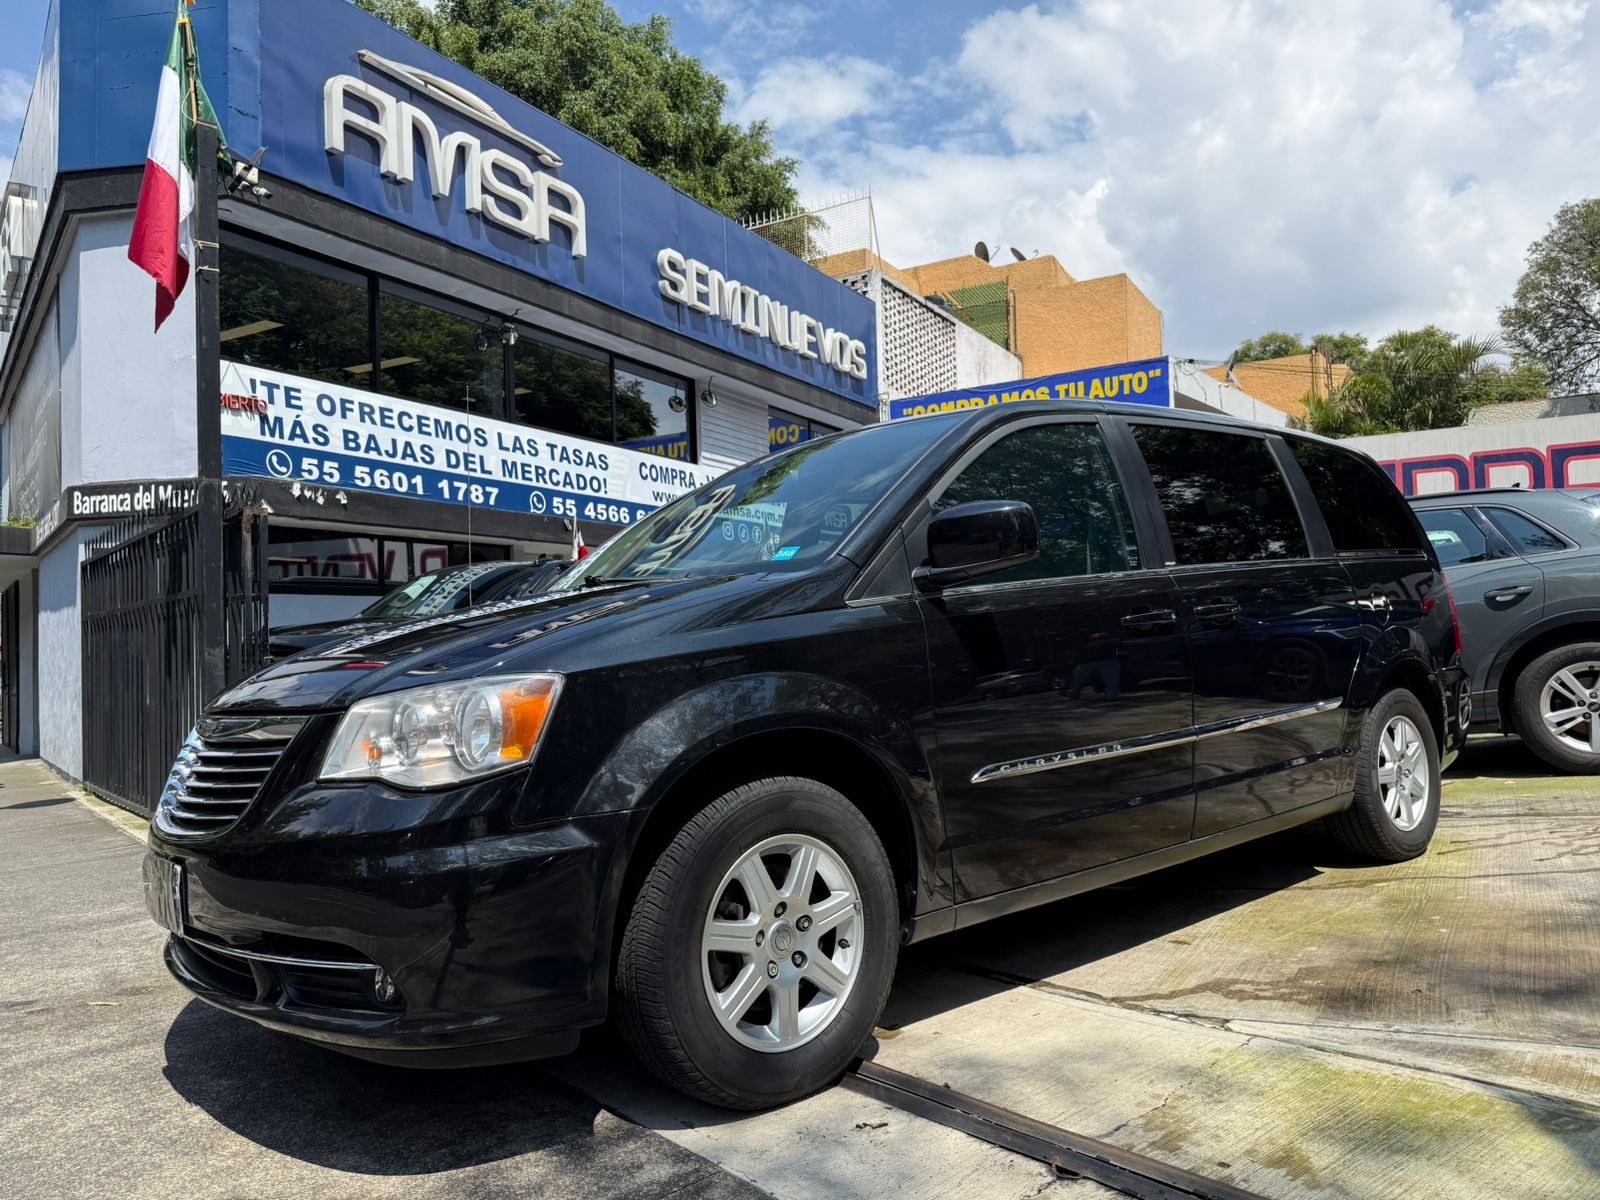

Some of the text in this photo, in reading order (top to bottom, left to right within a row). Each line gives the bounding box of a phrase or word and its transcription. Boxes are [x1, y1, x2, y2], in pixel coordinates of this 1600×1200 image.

[323, 75, 587, 259] AMSA
[657, 247, 868, 381] SEMINUEVOS
[260, 414, 609, 495] MÁS BAJAS DEL MERCADO!
[316, 393, 488, 447] OFRECEMOS
[497, 432, 540, 457] LAS
[547, 442, 609, 471] TASAS
[73, 490, 131, 515] Barranca
[134, 484, 155, 510] del
[301, 457, 499, 506] 55 5601 1787
[639, 461, 697, 489] COMPRA
[552, 497, 577, 518] 55
[584, 502, 631, 524] 4566
